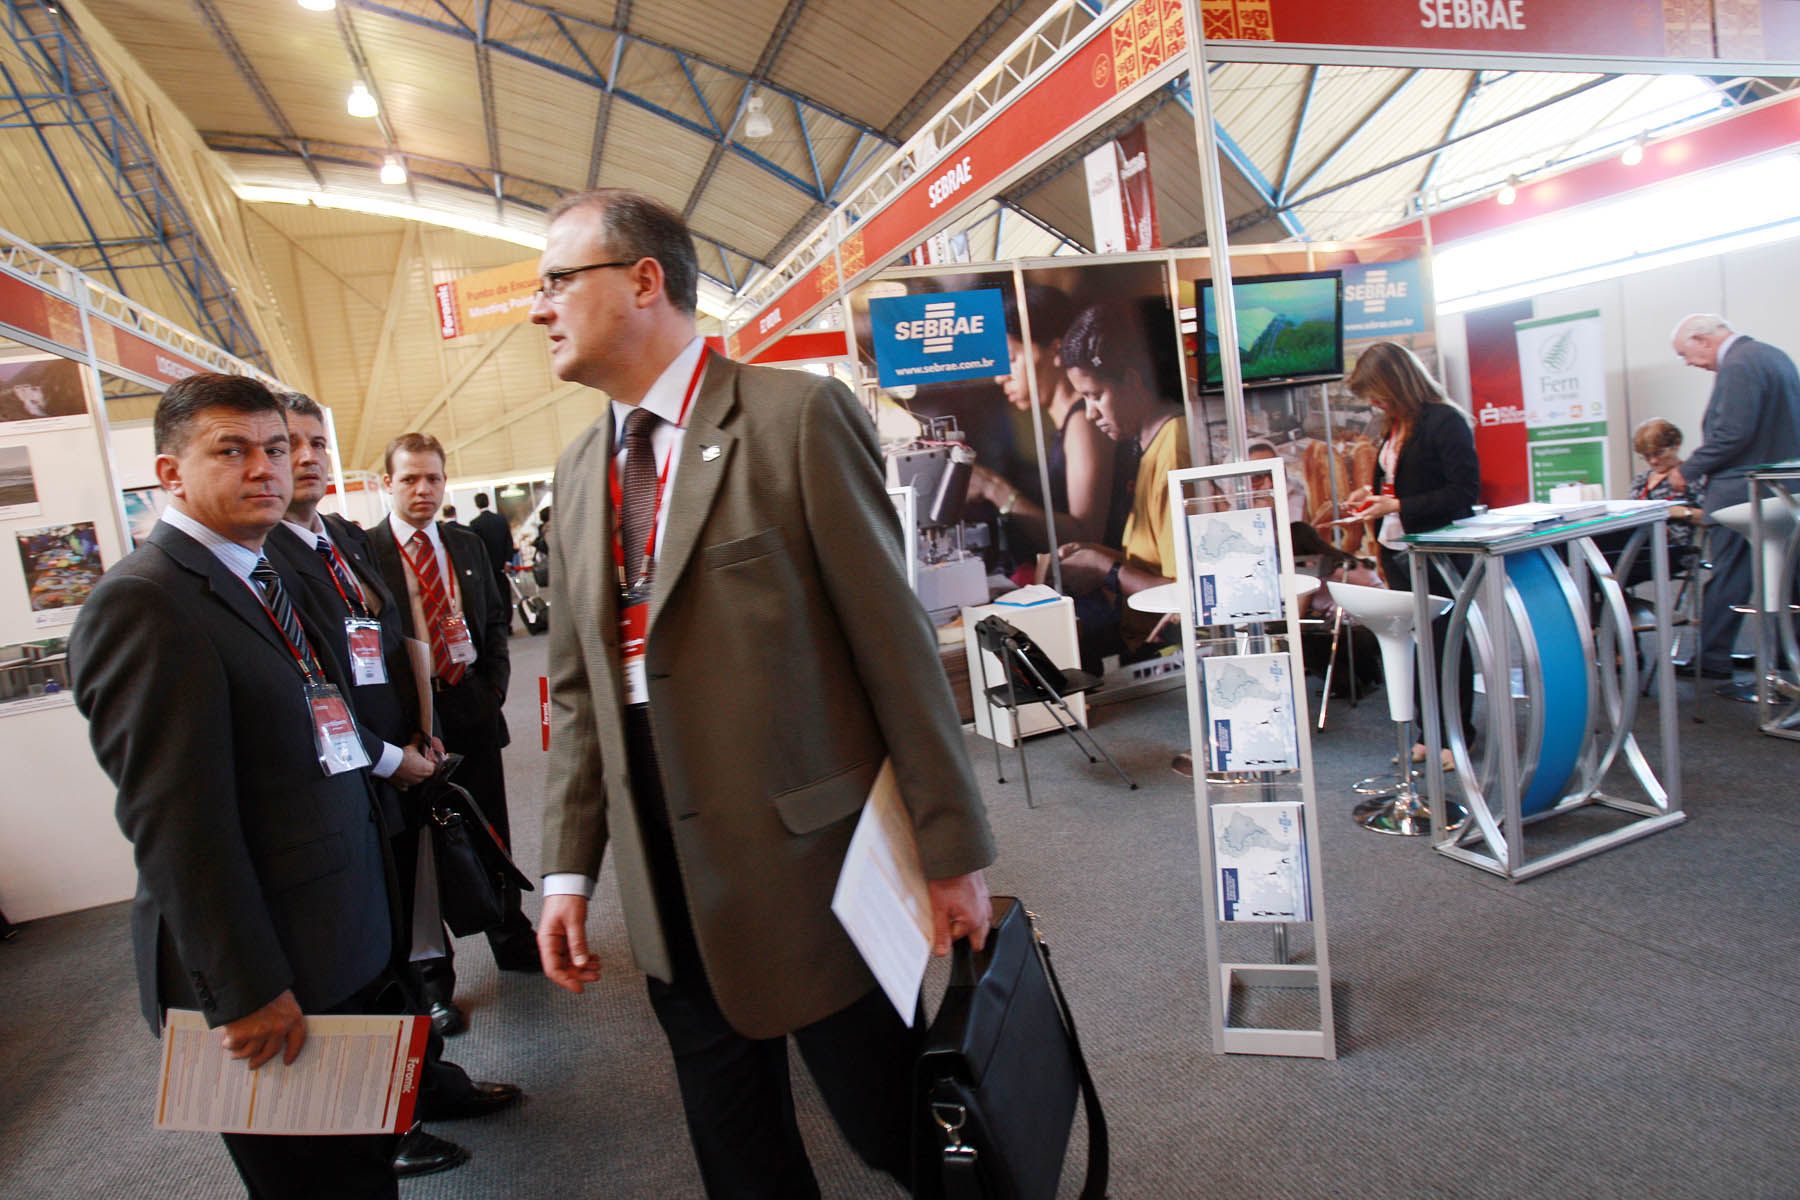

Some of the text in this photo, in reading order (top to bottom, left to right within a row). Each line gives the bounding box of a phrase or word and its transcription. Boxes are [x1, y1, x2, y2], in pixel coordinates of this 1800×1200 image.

[1419, 0, 1526, 30] SEBRAE
[928, 156, 973, 208] SEBRAE
[1344, 281, 1408, 302] SEBRAE
[894, 315, 985, 341] SEBRAE
[894, 357, 996, 376] www.sebrae.com.br
[1540, 375, 1580, 394] Fern
[402, 1056, 420, 1094] Foromic
